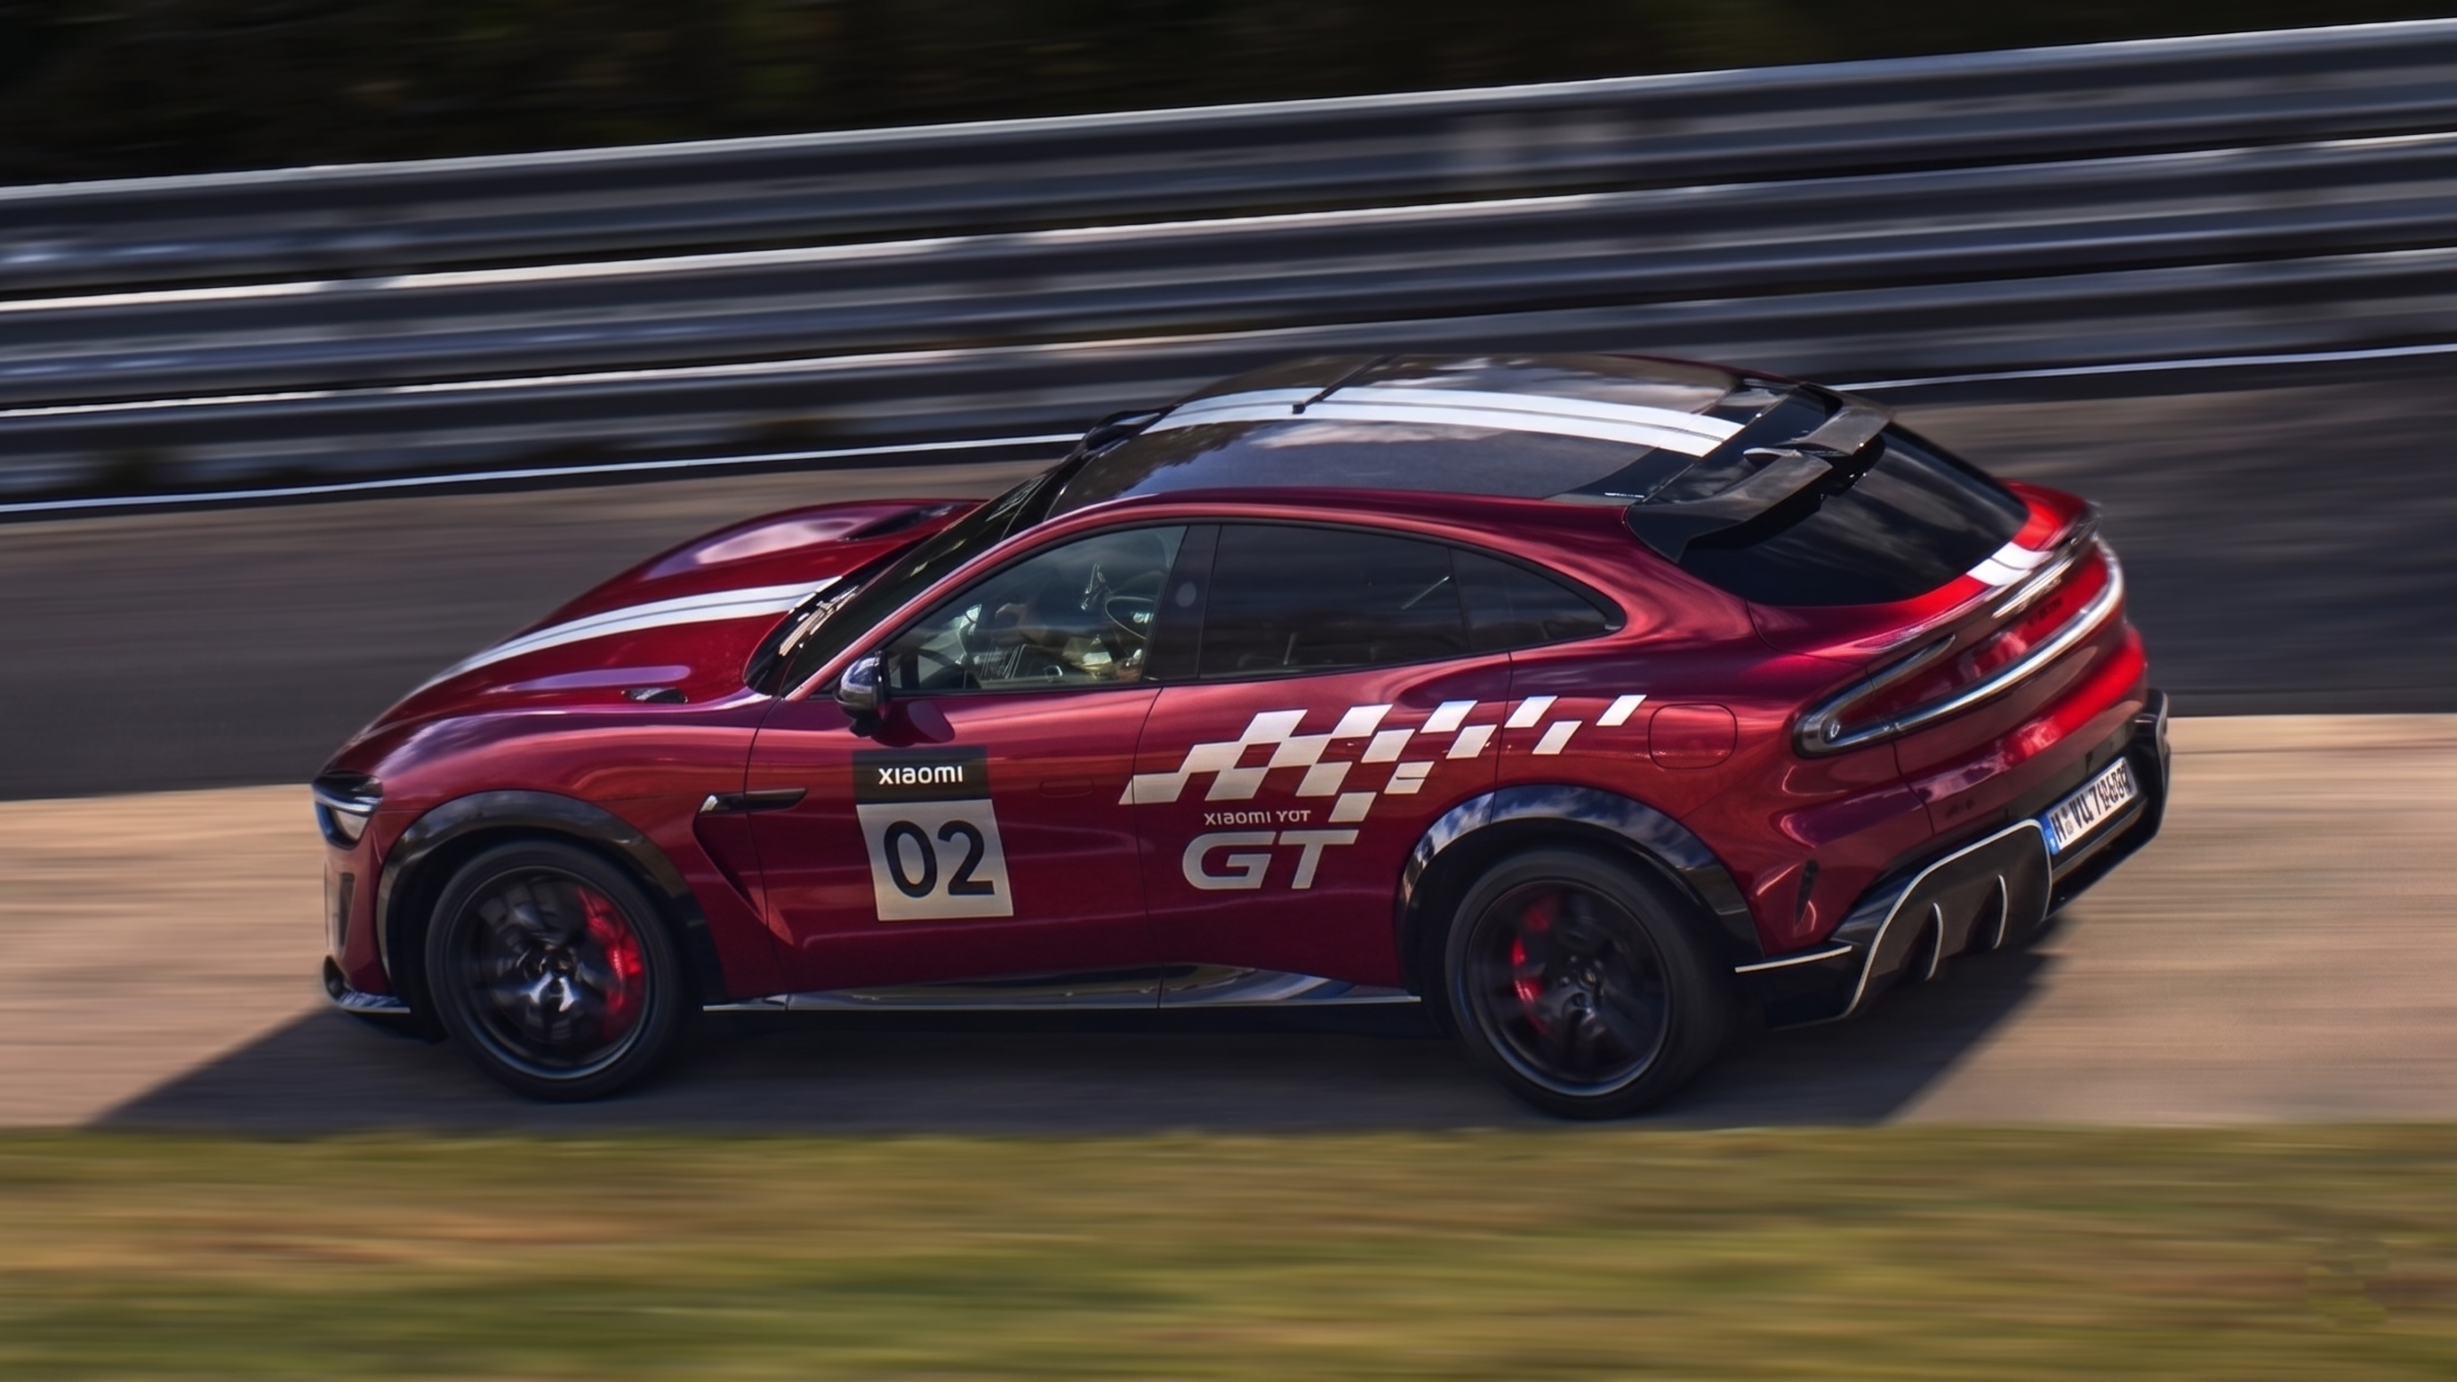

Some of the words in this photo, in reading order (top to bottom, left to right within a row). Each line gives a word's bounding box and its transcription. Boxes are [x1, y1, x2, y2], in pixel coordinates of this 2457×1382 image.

[878, 765, 963, 785] xiaomi
[1203, 811, 1271, 826] xiaomi
[883, 819, 996, 898] 02
[1182, 829, 1359, 890] GT
